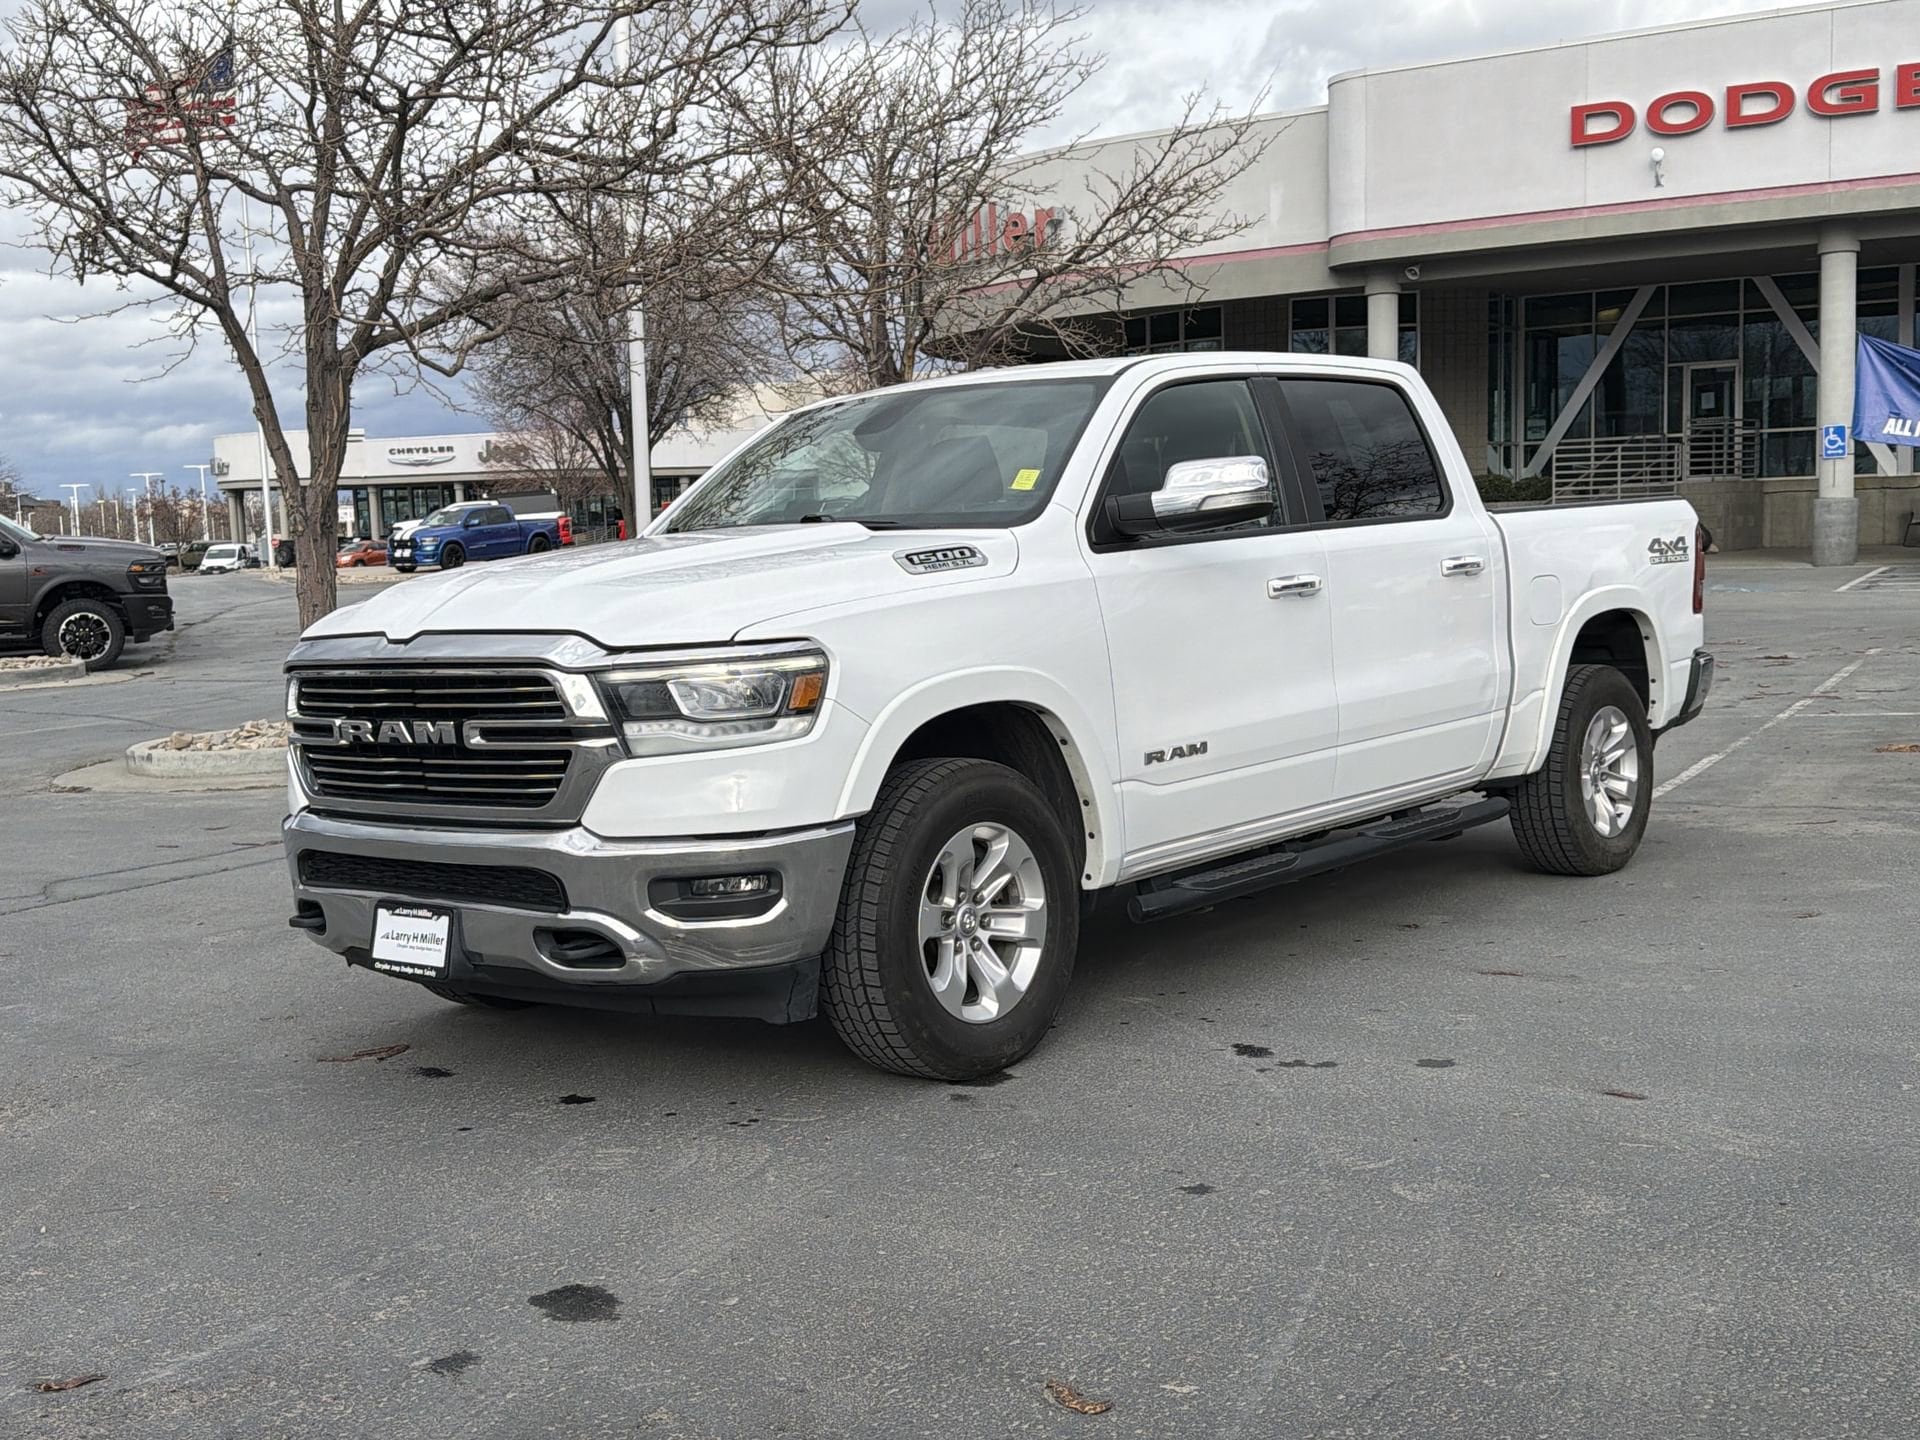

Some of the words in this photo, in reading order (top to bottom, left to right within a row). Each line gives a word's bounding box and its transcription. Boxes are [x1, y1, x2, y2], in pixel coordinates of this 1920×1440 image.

[1882, 418, 1912, 437] ALL
[388, 445, 455, 456] CHRYSLER
[907, 548, 972, 564] 1500
[923, 562, 950, 571] HEMI
[340, 719, 458, 744] RAM
[1144, 741, 1208, 766] RAM
[391, 930, 412, 944] Larry
[412, 931, 419, 943] H
[420, 932, 445, 945] Miller
